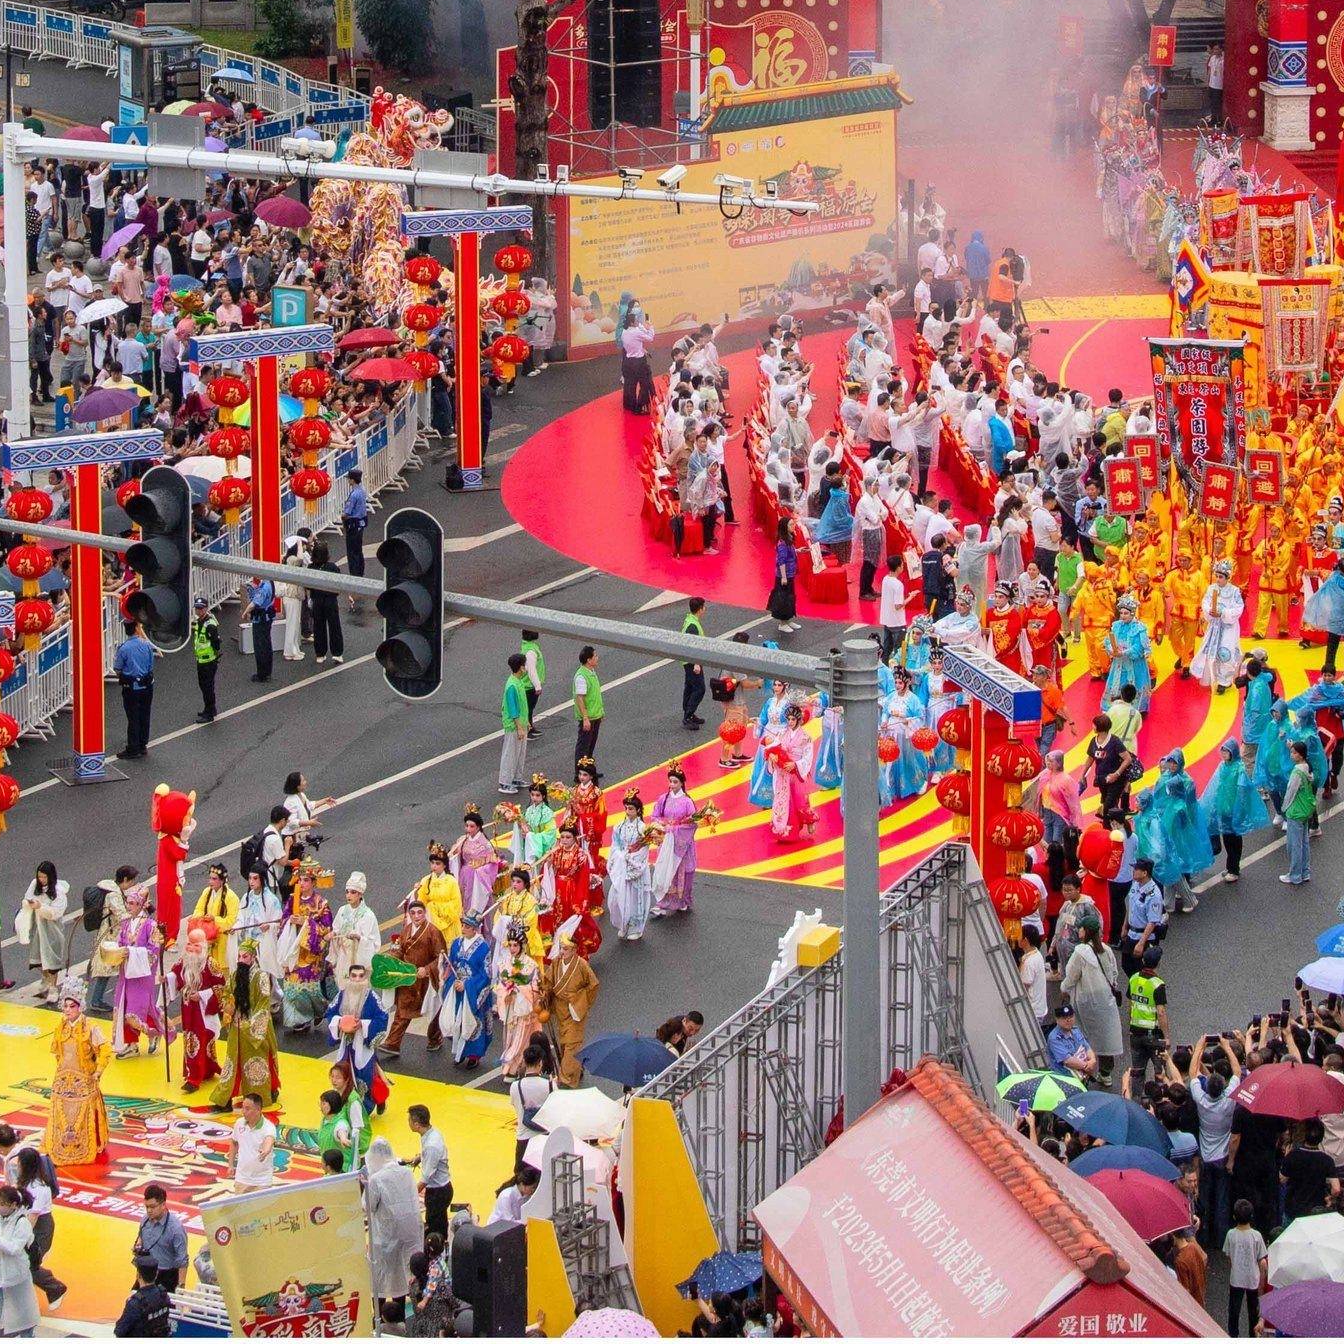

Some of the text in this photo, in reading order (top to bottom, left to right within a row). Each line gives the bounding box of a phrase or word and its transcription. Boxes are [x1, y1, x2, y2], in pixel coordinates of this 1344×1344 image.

[502, 254, 515, 268] 福
[418, 266, 431, 281] 福
[282, 299, 297, 323] P
[496, 299, 507, 313] 福
[517, 298, 529, 311] 福
[417, 314, 429, 328] 福
[502, 342, 513, 357] 福
[299, 378, 314, 393] 福
[225, 386, 241, 403] 福
[308, 428, 322, 444] 福
[218, 439, 233, 454] 福
[229, 486, 244, 502] 福
[305, 478, 320, 495] 福
[27, 503, 45, 519] 福
[17, 558, 34, 576] 福
[25, 612, 40, 628] 福
[942, 721, 958, 741] 福
[1014, 757, 1034, 777] 福
[944, 789, 963, 808] 福
[992, 826, 1010, 846] 福
[1024, 825, 1040, 846] 福
[1002, 893, 1023, 913] 福
[1057, 1313, 1148, 1336] 爱国 敬业
